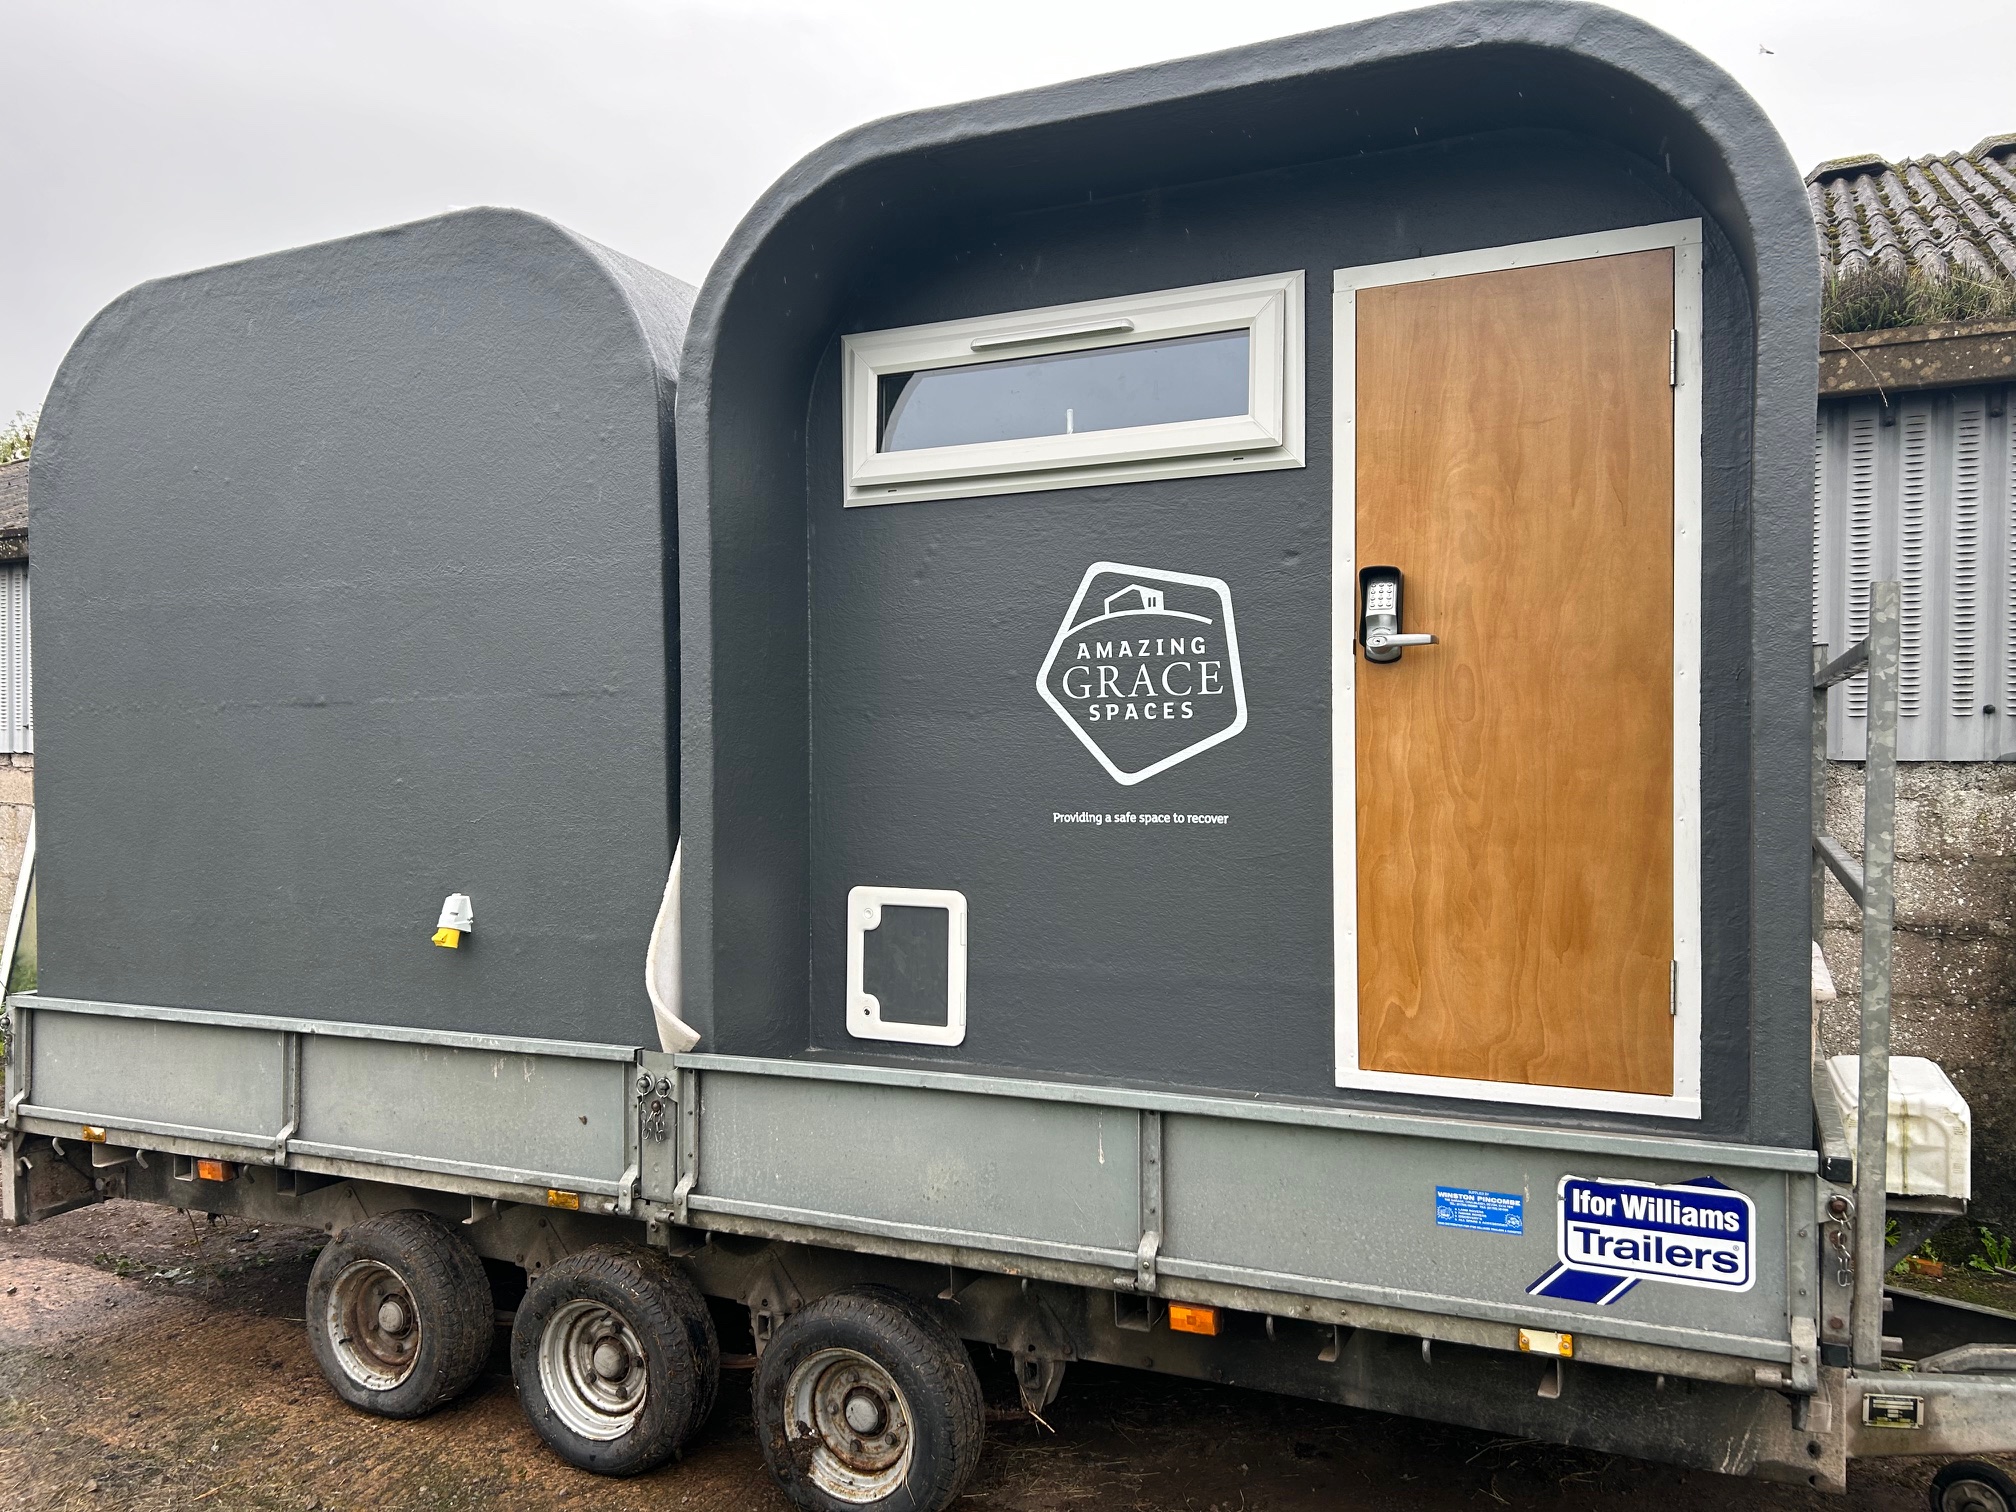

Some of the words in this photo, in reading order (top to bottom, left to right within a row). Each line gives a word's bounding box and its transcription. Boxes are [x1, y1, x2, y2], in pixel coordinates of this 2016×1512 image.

[1077, 637, 1206, 659] AMAZING
[1062, 660, 1223, 699] GRACE
[1090, 701, 1194, 721] SPACES
[1053, 812, 1102, 825] Providing
[1105, 814, 1112, 822] a
[1114, 812, 1136, 823] safe
[1139, 814, 1170, 825] space
[1173, 813, 1184, 823] to
[1187, 814, 1229, 824] recover
[1437, 1191, 1475, 1201] WINSTON
[1477, 1196, 1520, 1206] PINCOMBE
[1572, 1188, 1617, 1217] Ifor
[1620, 1194, 1740, 1232] Williams
[1573, 1226, 1739, 1273] Trailers
